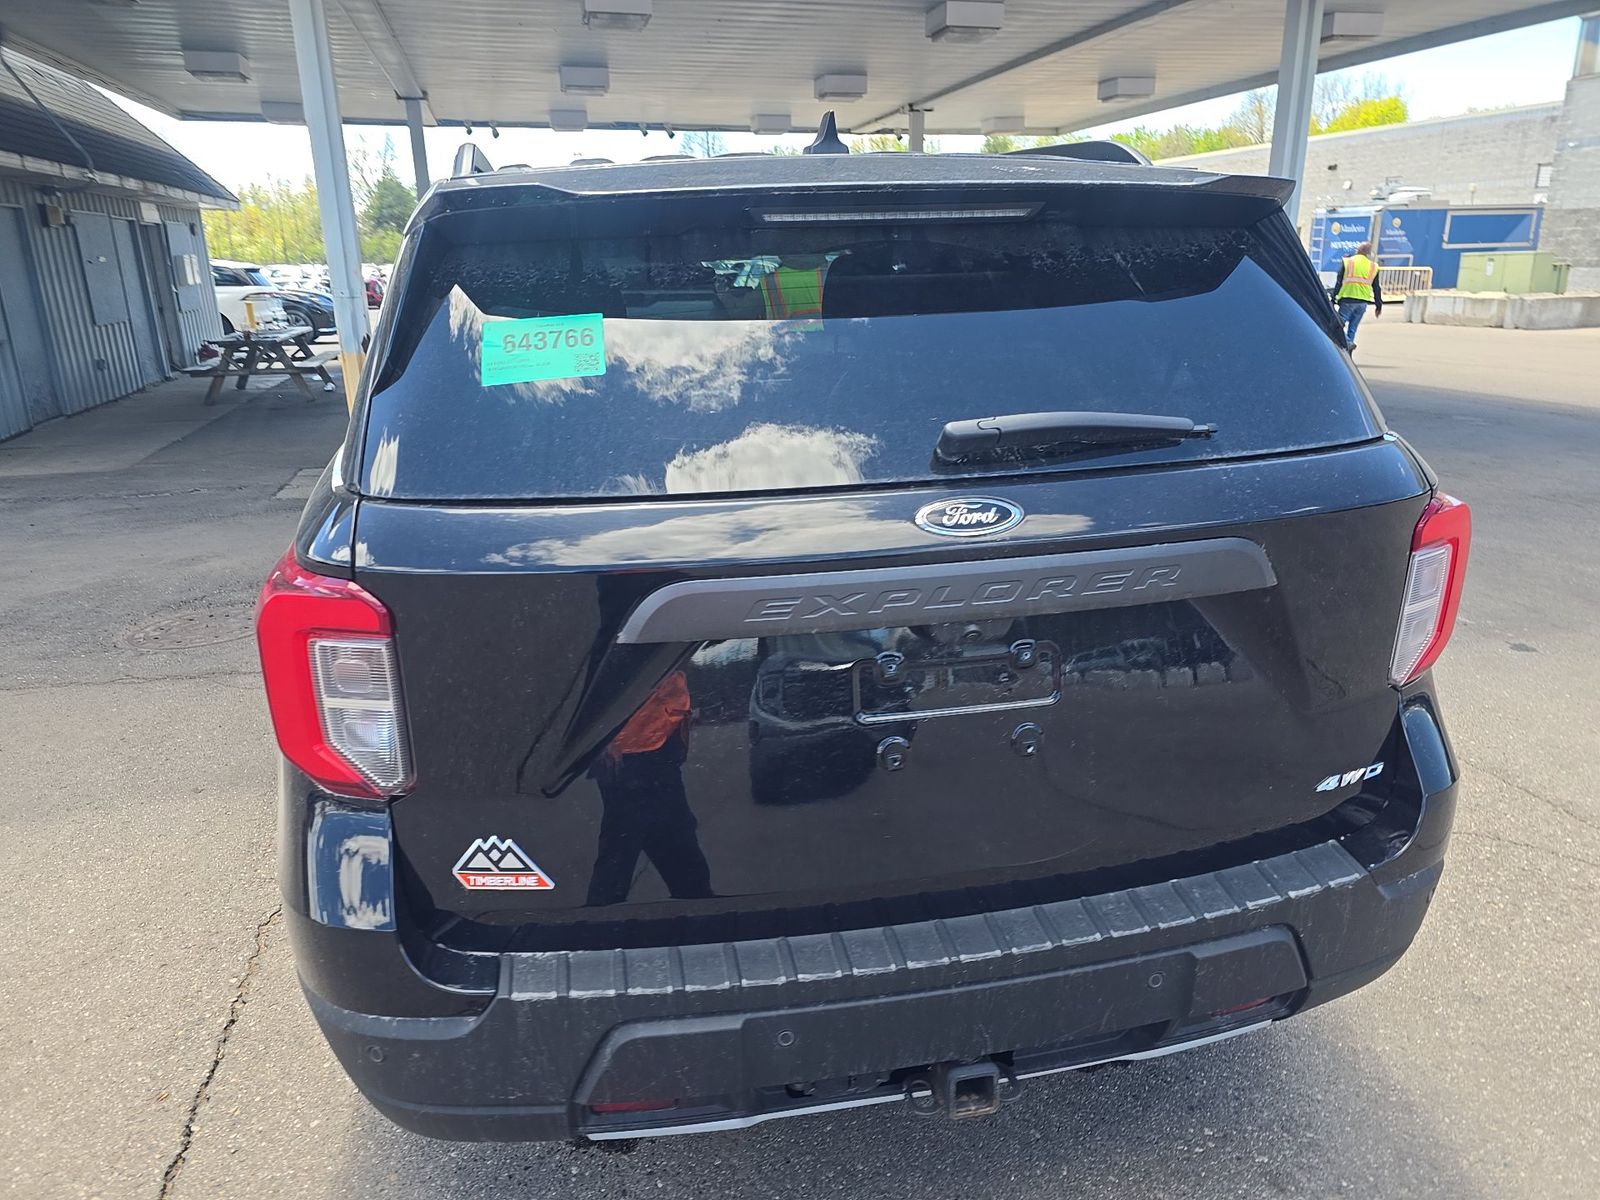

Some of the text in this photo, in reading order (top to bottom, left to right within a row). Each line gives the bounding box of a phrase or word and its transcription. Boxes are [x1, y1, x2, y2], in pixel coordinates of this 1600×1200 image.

[503, 327, 594, 353] 643766
[942, 504, 999, 526] Ford
[744, 565, 1182, 623] EXPLORER
[1314, 762, 1384, 792] 4WD
[467, 876, 540, 886] TIMBERLINE
